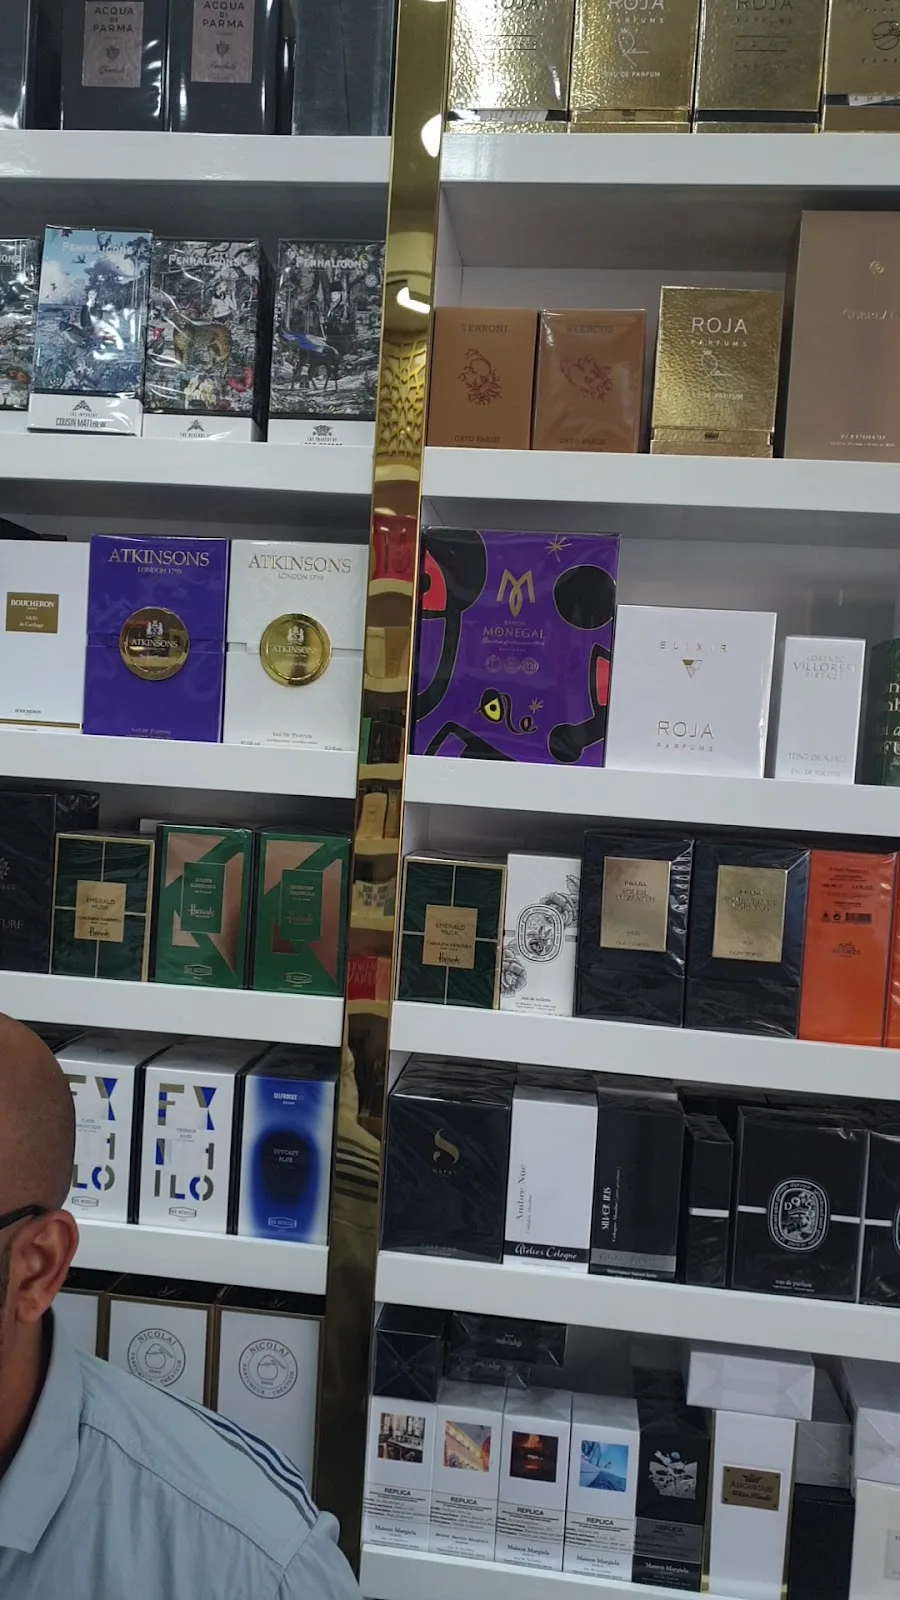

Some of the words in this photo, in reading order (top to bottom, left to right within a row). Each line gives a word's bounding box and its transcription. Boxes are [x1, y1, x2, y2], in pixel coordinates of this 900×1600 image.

[203, 0, 245, 10] ACQUA
[608, 0, 665, 10] ROJA
[736, 0, 793, 10] ROJA
[94, 6, 134, 16] ACQUA
[203, 18, 244, 28] PARMA
[93, 24, 134, 33] PARMA
[462, 324, 508, 332] TERRONI
[692, 316, 748, 334] ROJA
[690, 339, 748, 348] PARFUMS
[56, 418, 76, 426] COUSIN
[108, 548, 210, 567] ATKINSONS
[248, 554, 351, 573] ATKINSONS
[10, 599, 54, 608] BOUCHERON
[483, 626, 546, 640] MONEGAL
[130, 638, 178, 648] ATKINSONS
[660, 641, 727, 652] ELIXIR
[793, 660, 857, 673] VILLORESI
[657, 721, 714, 739] ROJA
[656, 742, 714, 752] PARFUMS
[436, 922, 466, 930] EMERALD
[517, 1164, 526, 1184] Nue
[602, 1186, 612, 1201] IRIS
[516, 1187, 524, 1222] Ambre
[601, 1202, 611, 1230] SILVER
[514, 1243, 545, 1256] Atelier
[546, 1246, 578, 1260] Cologne
[138, 1330, 177, 1346] NICOLAI
[249, 1342, 289, 1357] NICOLAI
[384, 1488, 411, 1496] REPLICA
[450, 1496, 478, 1506] REPLICA
[517, 1507, 544, 1516] REPLICA
[586, 1516, 614, 1526] REPLICA
[375, 1524, 394, 1532] Maison
[394, 1526, 416, 1536] Margiela
[508, 1544, 526, 1552] Maison
[528, 1547, 550, 1556] Margiela
[576, 1554, 596, 1562] Maison
[597, 1557, 620, 1566] Margiela
[666, 1564, 690, 1574] Margiela
